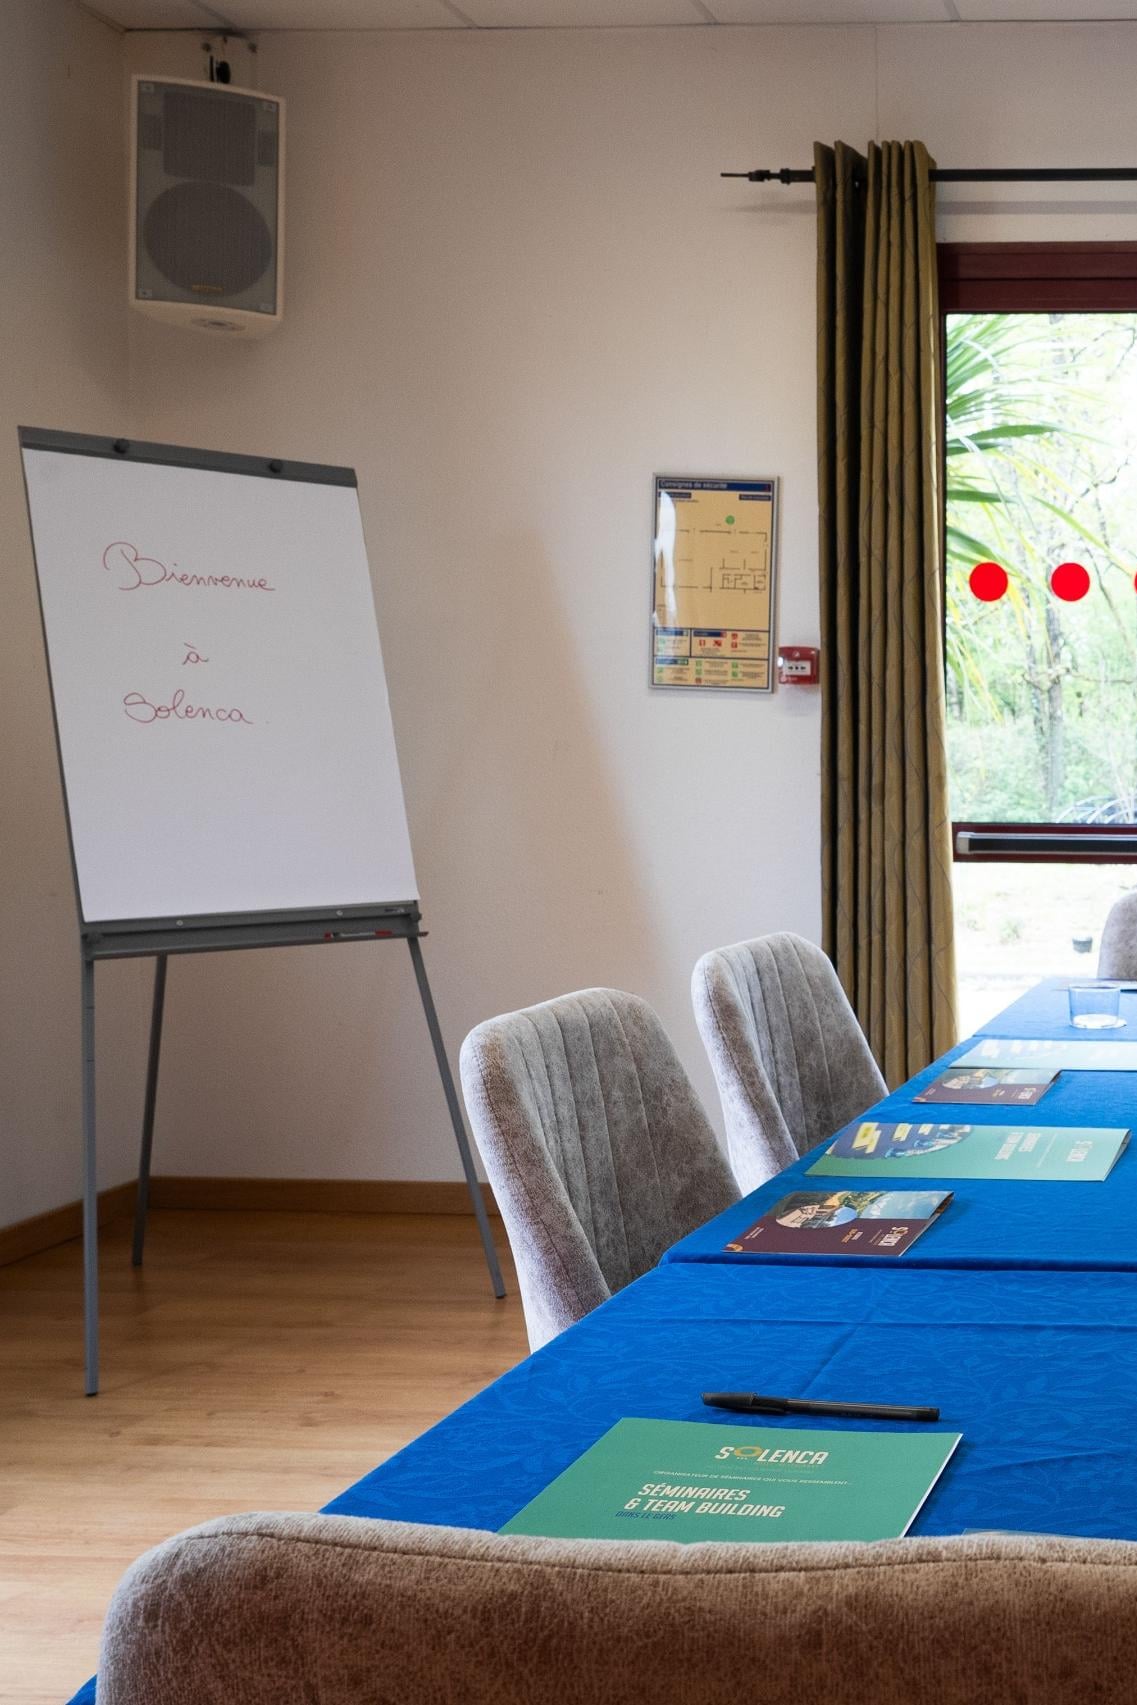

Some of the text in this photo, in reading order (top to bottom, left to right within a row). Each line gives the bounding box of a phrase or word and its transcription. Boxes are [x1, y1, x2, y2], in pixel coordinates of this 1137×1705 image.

[103, 541, 276, 591] Bienvenue
[181, 642, 209, 666] à
[123, 689, 254, 724] Solenca
[715, 1446, 829, 1465] SOLENCA
[638, 1483, 751, 1501] SÉMINAIRES
[623, 1498, 785, 1518] & TEAM BUILDING
